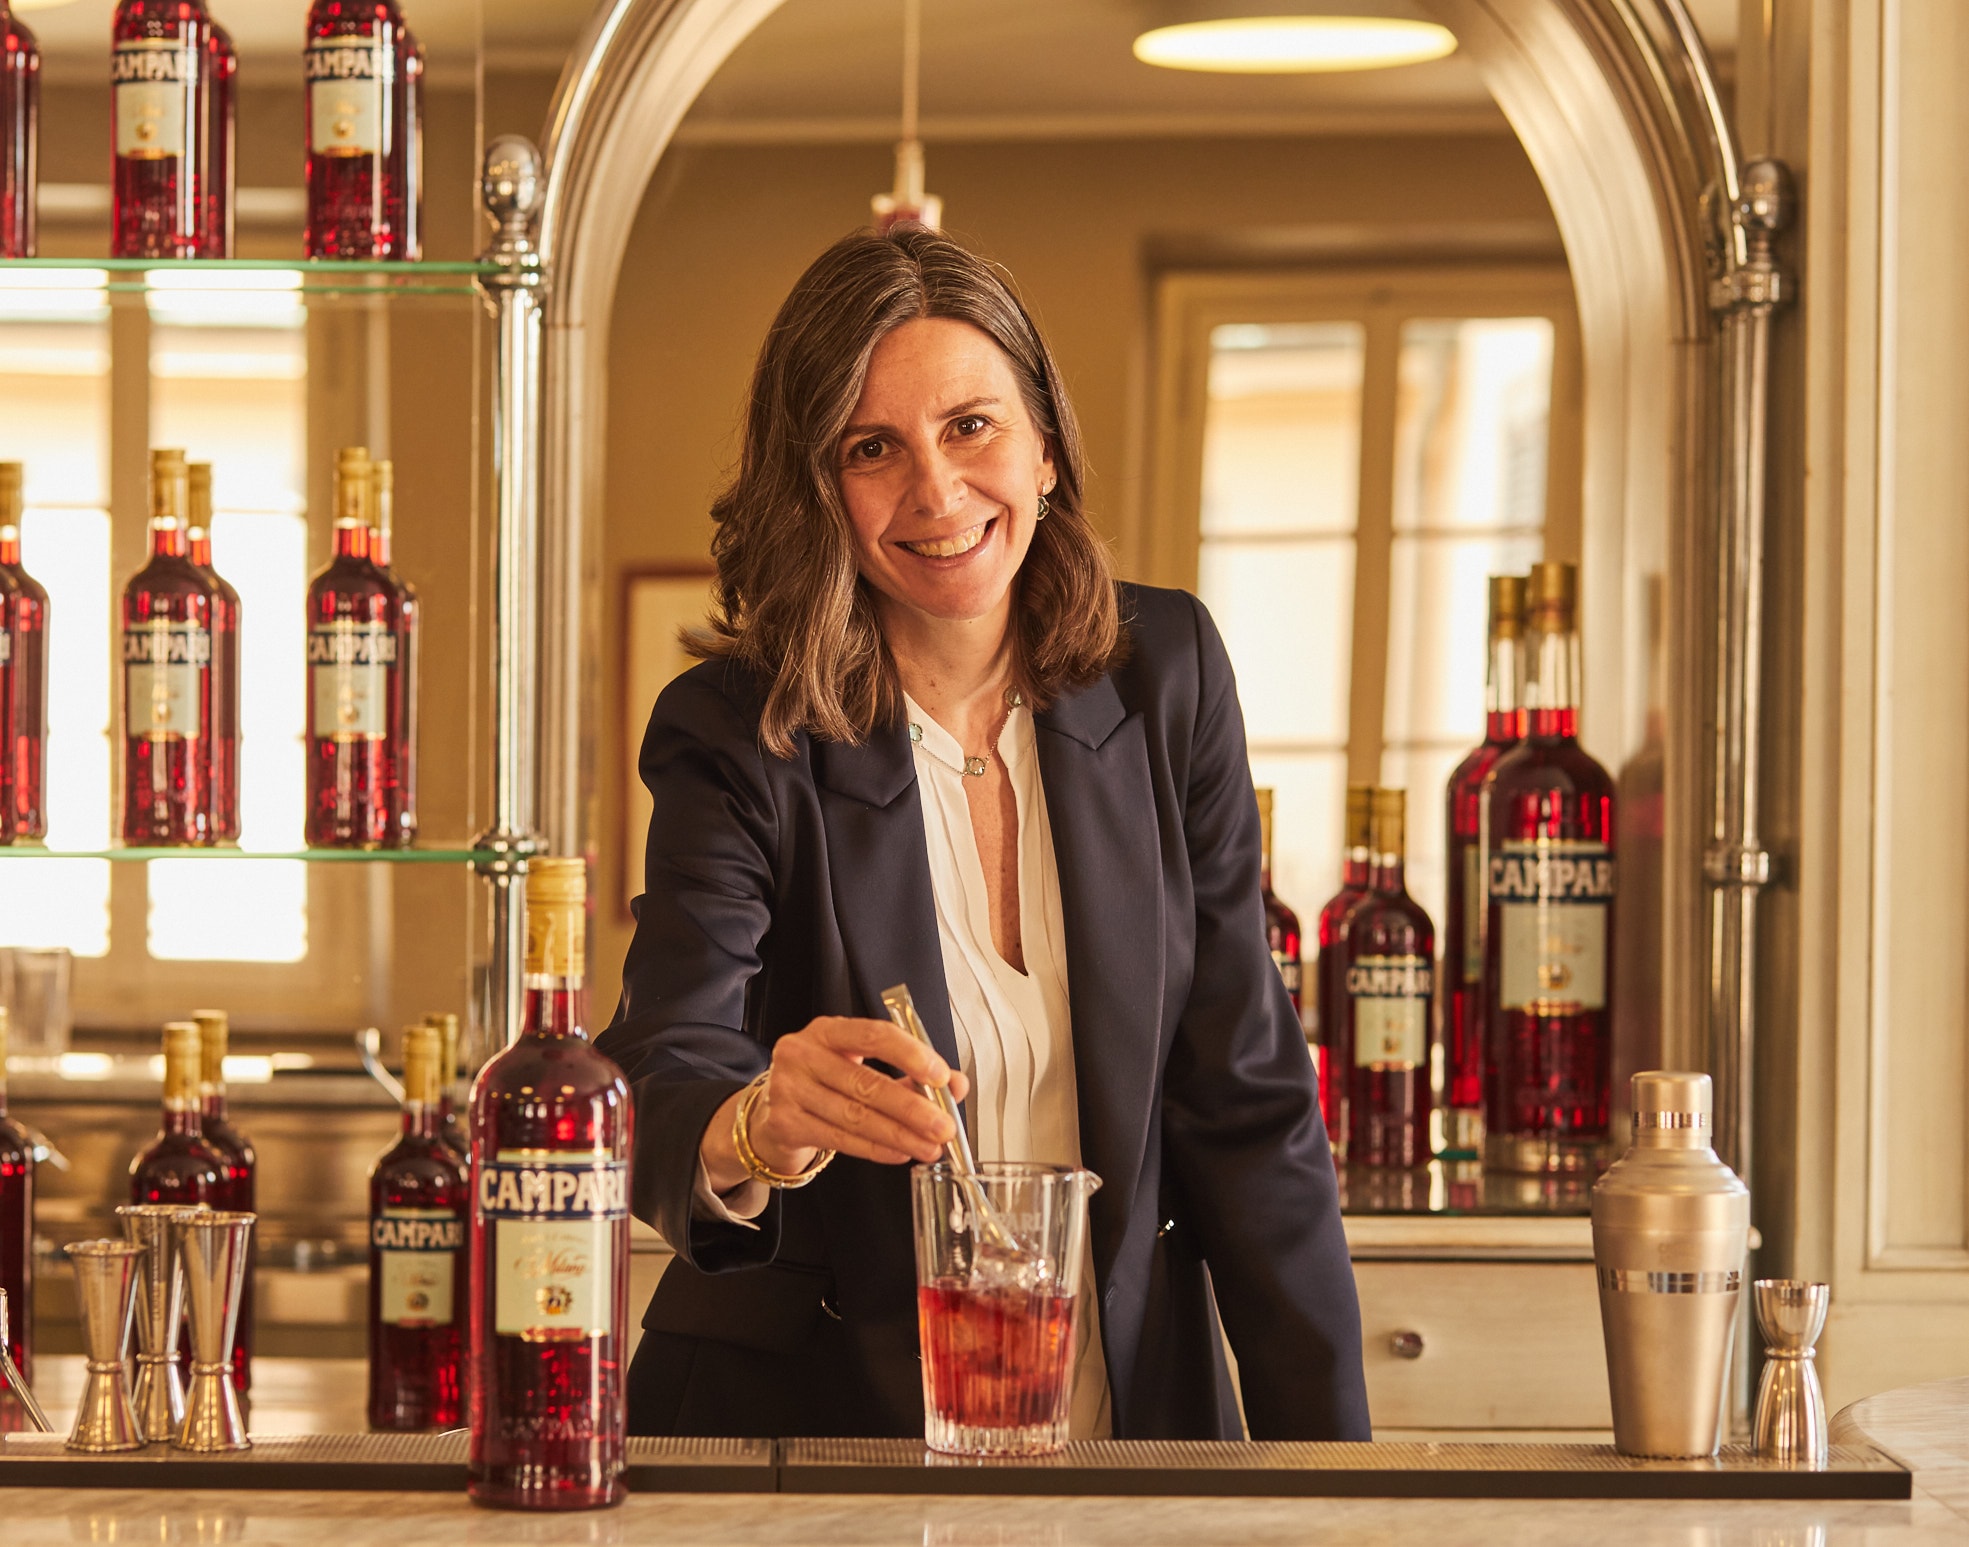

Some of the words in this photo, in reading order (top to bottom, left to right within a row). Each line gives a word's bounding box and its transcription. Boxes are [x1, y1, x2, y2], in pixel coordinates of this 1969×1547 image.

[1489, 857, 1613, 897] CAMPAR
[1345, 967, 1432, 994] CAMPAR
[480, 1168, 627, 1212] CAMPARI
